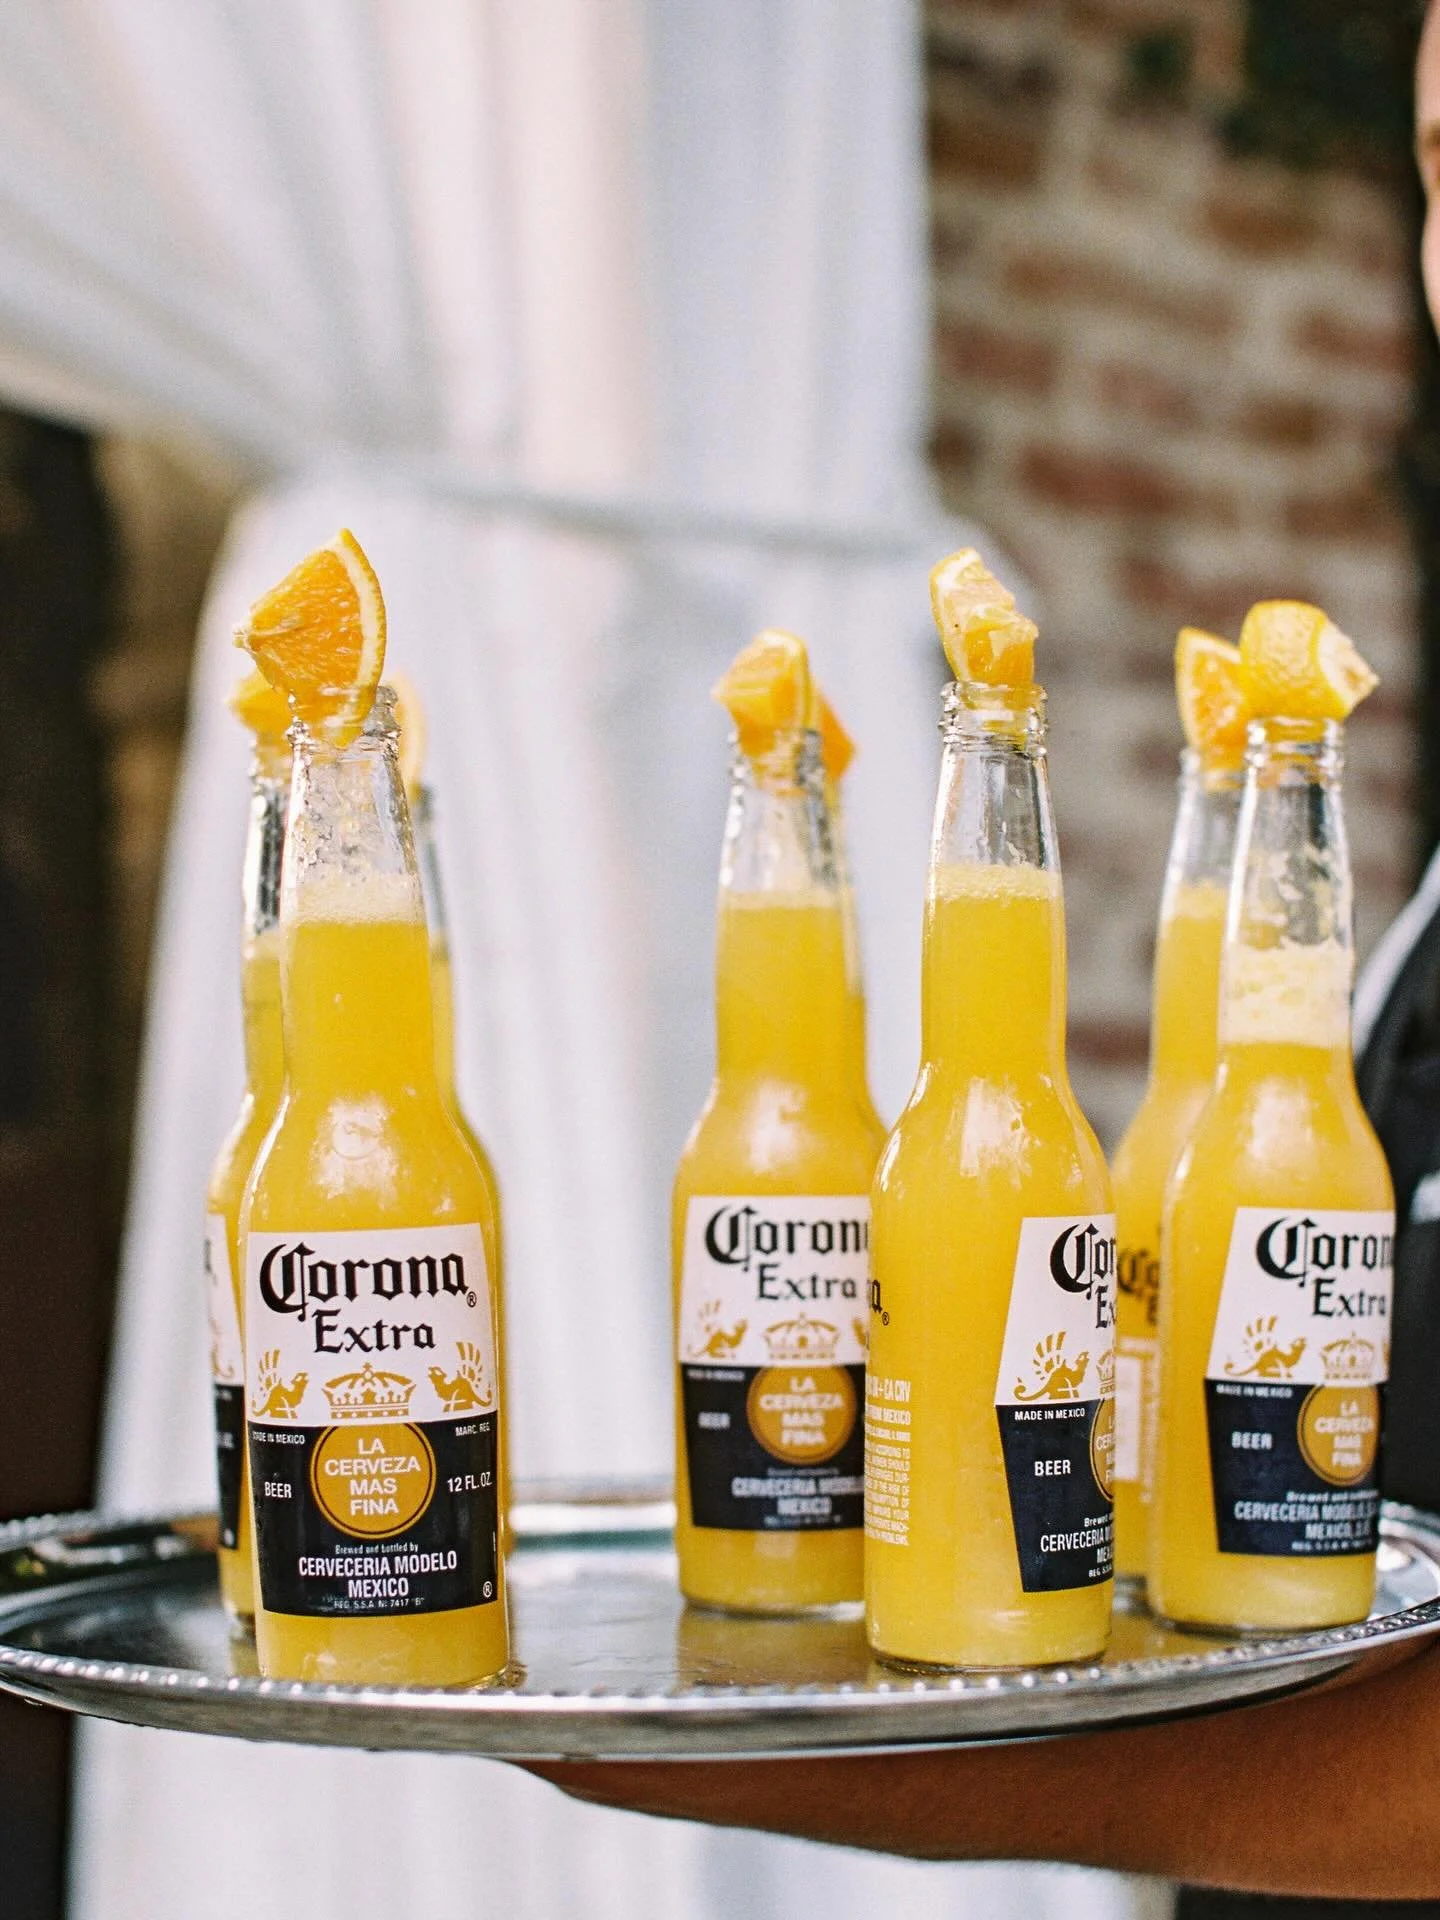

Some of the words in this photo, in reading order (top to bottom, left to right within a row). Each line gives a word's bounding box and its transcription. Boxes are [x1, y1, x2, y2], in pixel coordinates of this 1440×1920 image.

[259, 1242, 468, 1321] Corona
[756, 1262, 857, 1300] Extra
[313, 1308, 437, 1354] Extra
[790, 1376, 815, 1392] LA
[760, 1393, 844, 1410] CERVEZA
[781, 1412, 824, 1428] MAS
[1014, 1411, 1043, 1421] MADE
[1044, 1410, 1054, 1420] IN
[1055, 1408, 1086, 1419] MEXICO
[276, 1434, 306, 1444] MEXICO
[357, 1438, 386, 1455] LA
[1231, 1431, 1273, 1450] BEER
[324, 1458, 421, 1477] CERVEZA
[1034, 1459, 1071, 1476] BEER
[264, 1481, 292, 1498] BEER
[350, 1478, 397, 1496] MAS
[447, 1477, 462, 1493] 12
[465, 1475, 479, 1490] FL.
[350, 1499, 399, 1517] FINA
[1234, 1500, 1319, 1522] CERVECERIA
[335, 1544, 364, 1554] Brewed
[365, 1544, 379, 1553] and
[381, 1543, 407, 1553] bottled
[409, 1542, 419, 1552] by
[1040, 1528, 1104, 1552] CERVECERIA
[299, 1556, 391, 1577] CERVECERIA
[394, 1550, 458, 1575] MODELO
[348, 1578, 409, 1598] MEXICO
[390, 1599, 409, 1608] 7417
